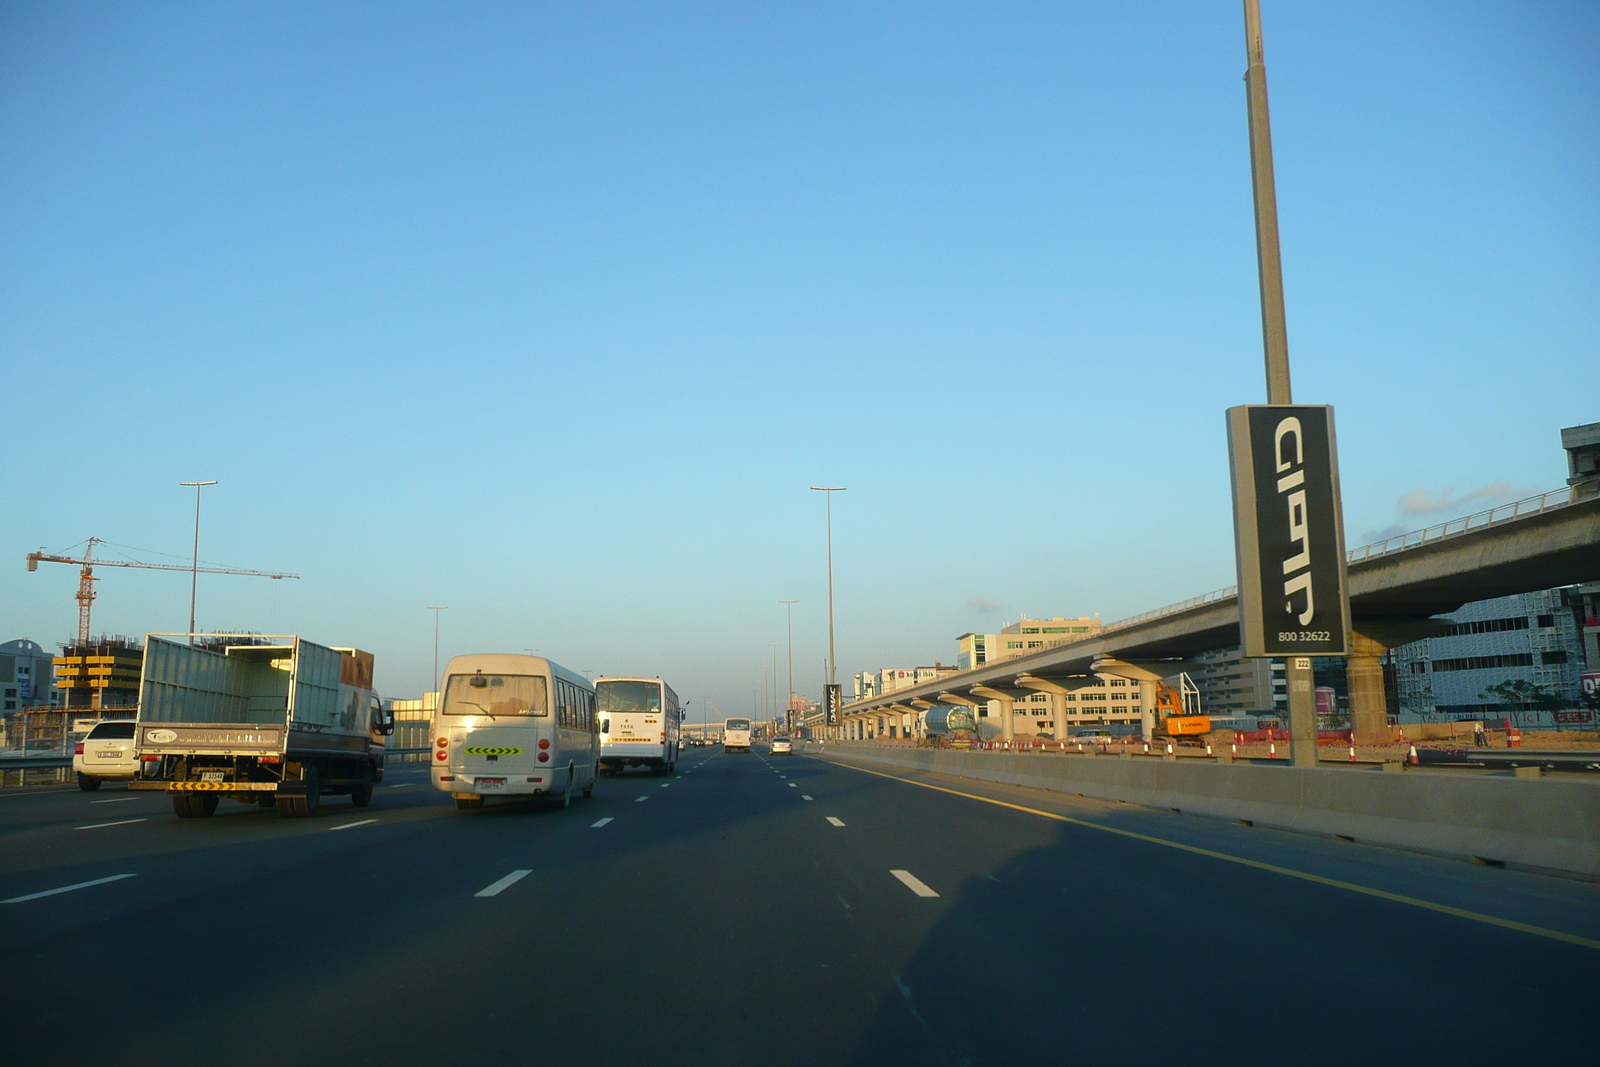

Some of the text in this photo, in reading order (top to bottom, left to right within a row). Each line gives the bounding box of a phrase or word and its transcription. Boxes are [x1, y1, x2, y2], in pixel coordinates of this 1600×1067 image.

[1278, 631, 1331, 642] 800 32622
[829, 686, 837, 723] DAMAC
